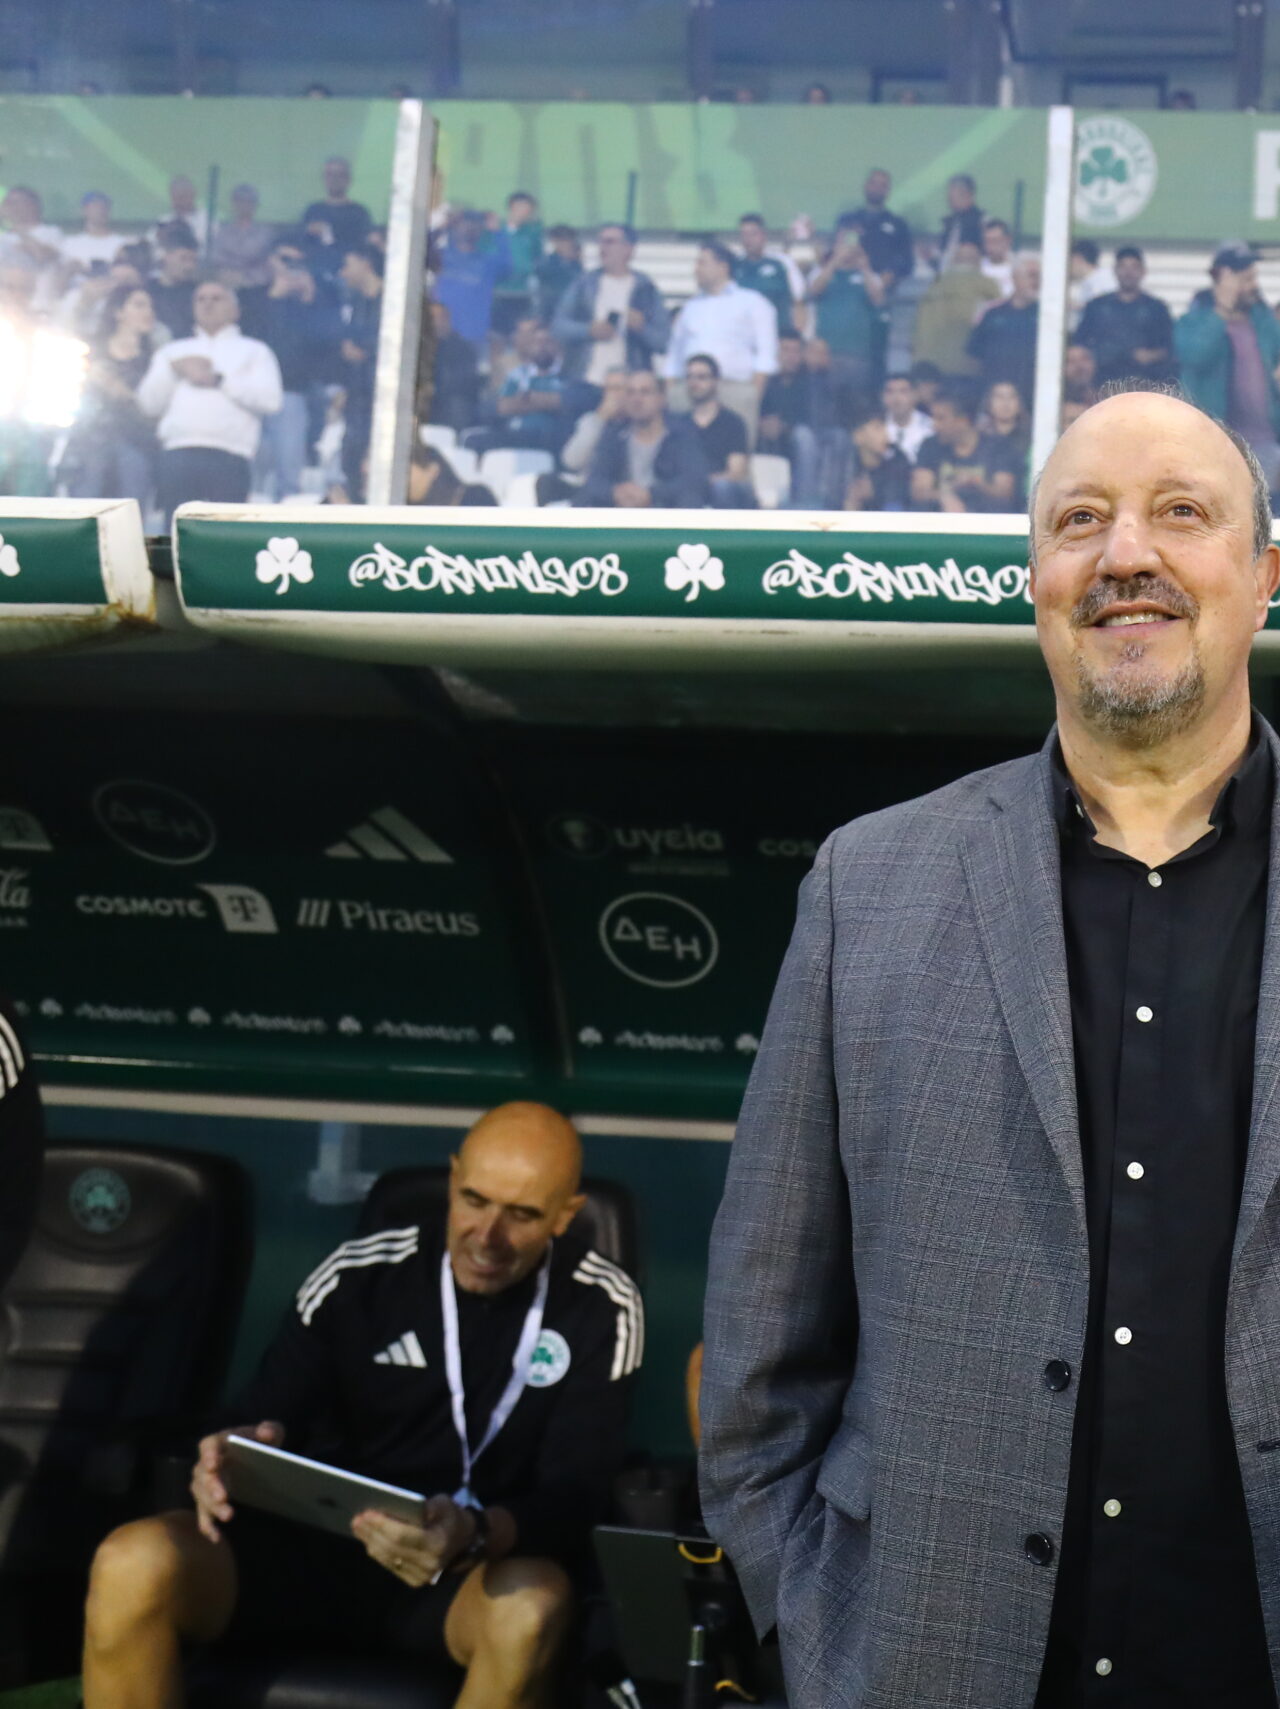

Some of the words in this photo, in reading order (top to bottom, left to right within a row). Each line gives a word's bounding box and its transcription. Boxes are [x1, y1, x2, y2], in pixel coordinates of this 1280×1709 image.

[349, 541, 629, 597] @BORNIN1908
[75, 894, 208, 918] COSMOTE
[336, 899, 480, 937] Piraeus
[612, 915, 704, 962] ΔΕΗ
